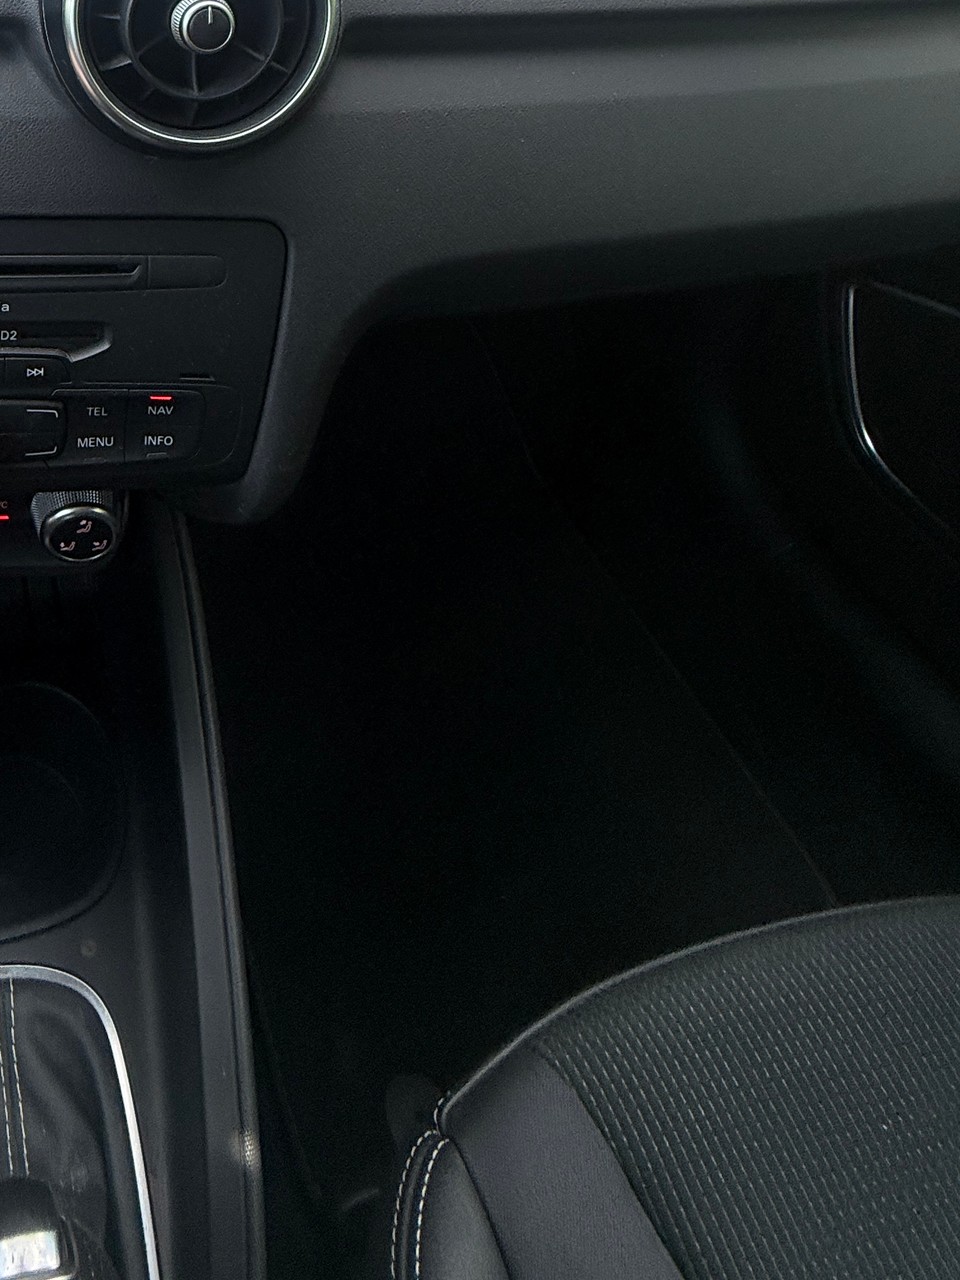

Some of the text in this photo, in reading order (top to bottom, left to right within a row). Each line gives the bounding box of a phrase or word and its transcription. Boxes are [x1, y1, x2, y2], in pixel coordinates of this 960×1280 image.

[87, 407, 108, 417] TEL
[147, 405, 174, 415] NAV
[77, 437, 114, 448] MENU
[144, 435, 174, 446] INFO
